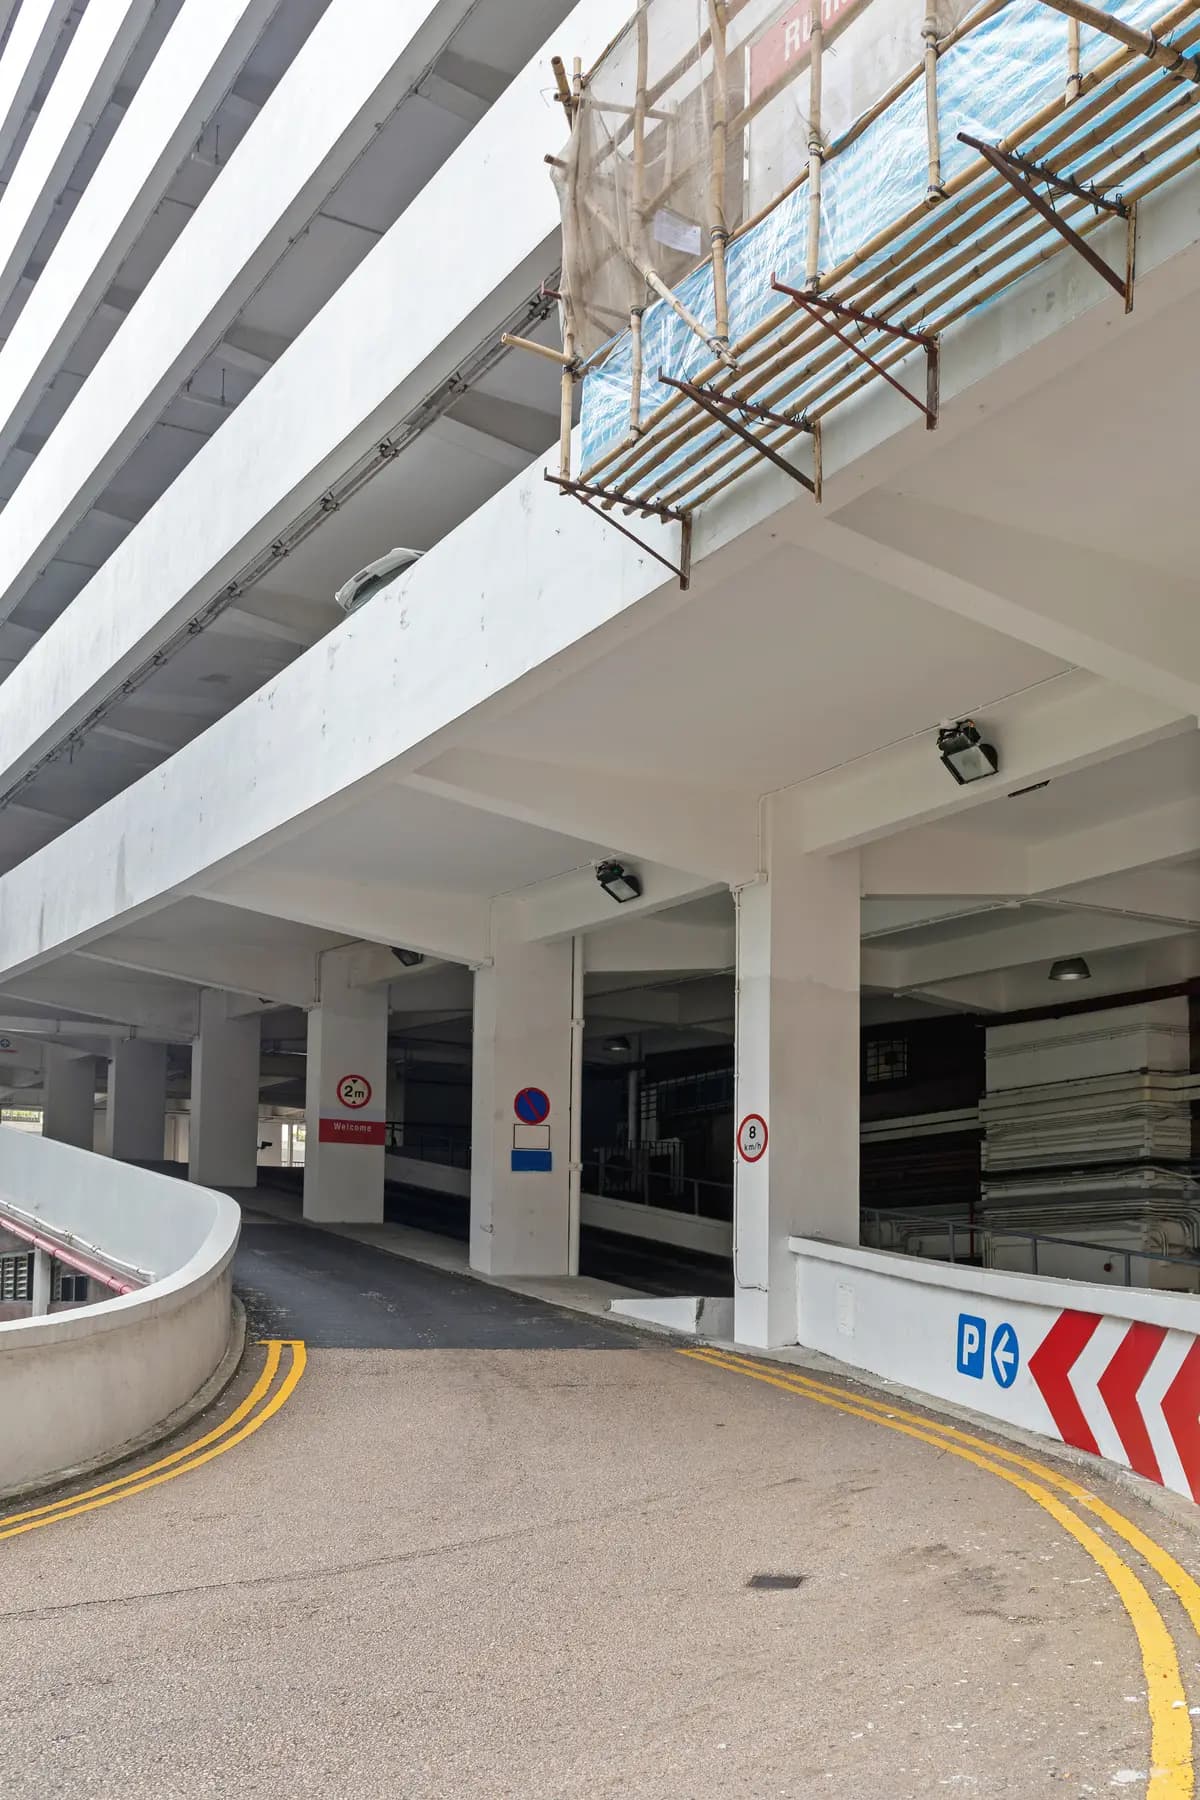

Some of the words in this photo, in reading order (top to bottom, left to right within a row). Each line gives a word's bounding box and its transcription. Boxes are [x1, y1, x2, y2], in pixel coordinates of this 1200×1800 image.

[333, 1122, 372, 1133] Welcome
[749, 1126, 756, 1139] 8
[744, 1142, 762, 1151] km/h
[962, 1323, 980, 1366] P
